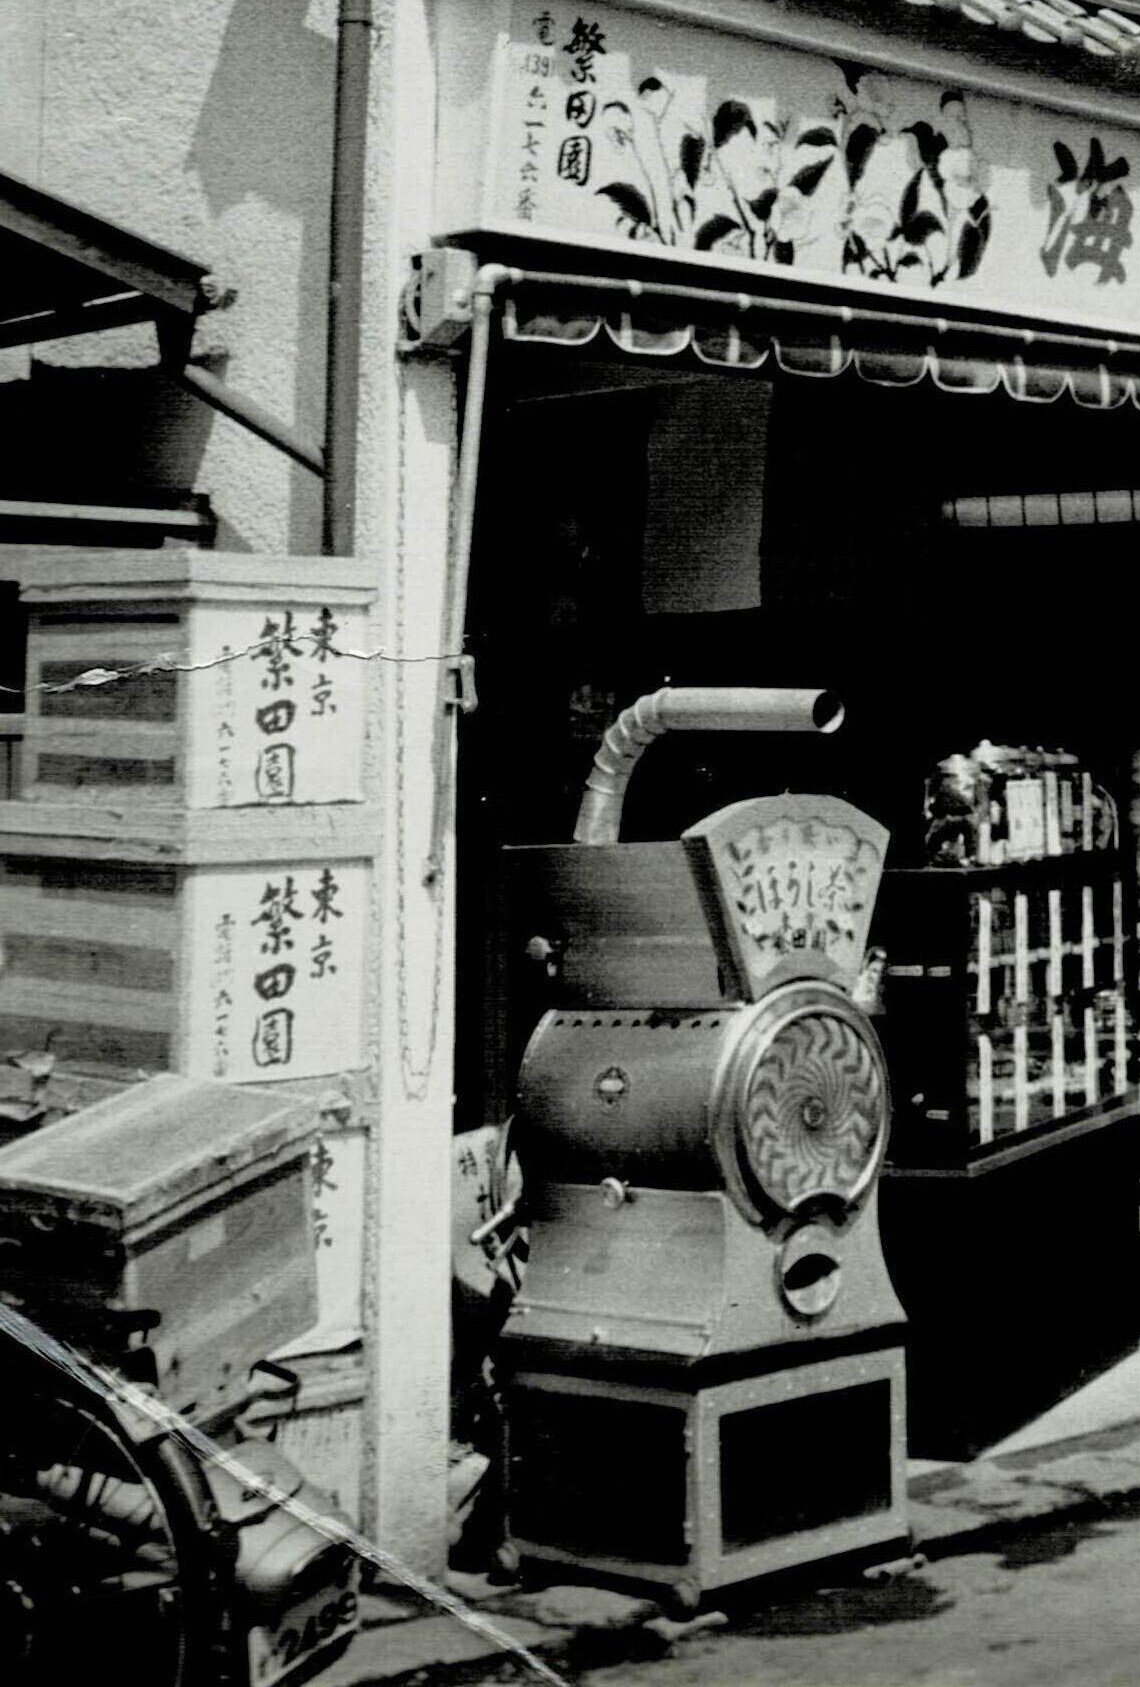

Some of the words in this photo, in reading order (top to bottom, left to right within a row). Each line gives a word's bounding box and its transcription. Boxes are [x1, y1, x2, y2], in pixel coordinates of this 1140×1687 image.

[557, 16, 607, 187] 繁田園
[250, 610, 304, 798] 繁田園
[310, 607, 342, 716] 東京
[250, 876, 305, 1068] 繁田園
[310, 868, 344, 979] 東京
